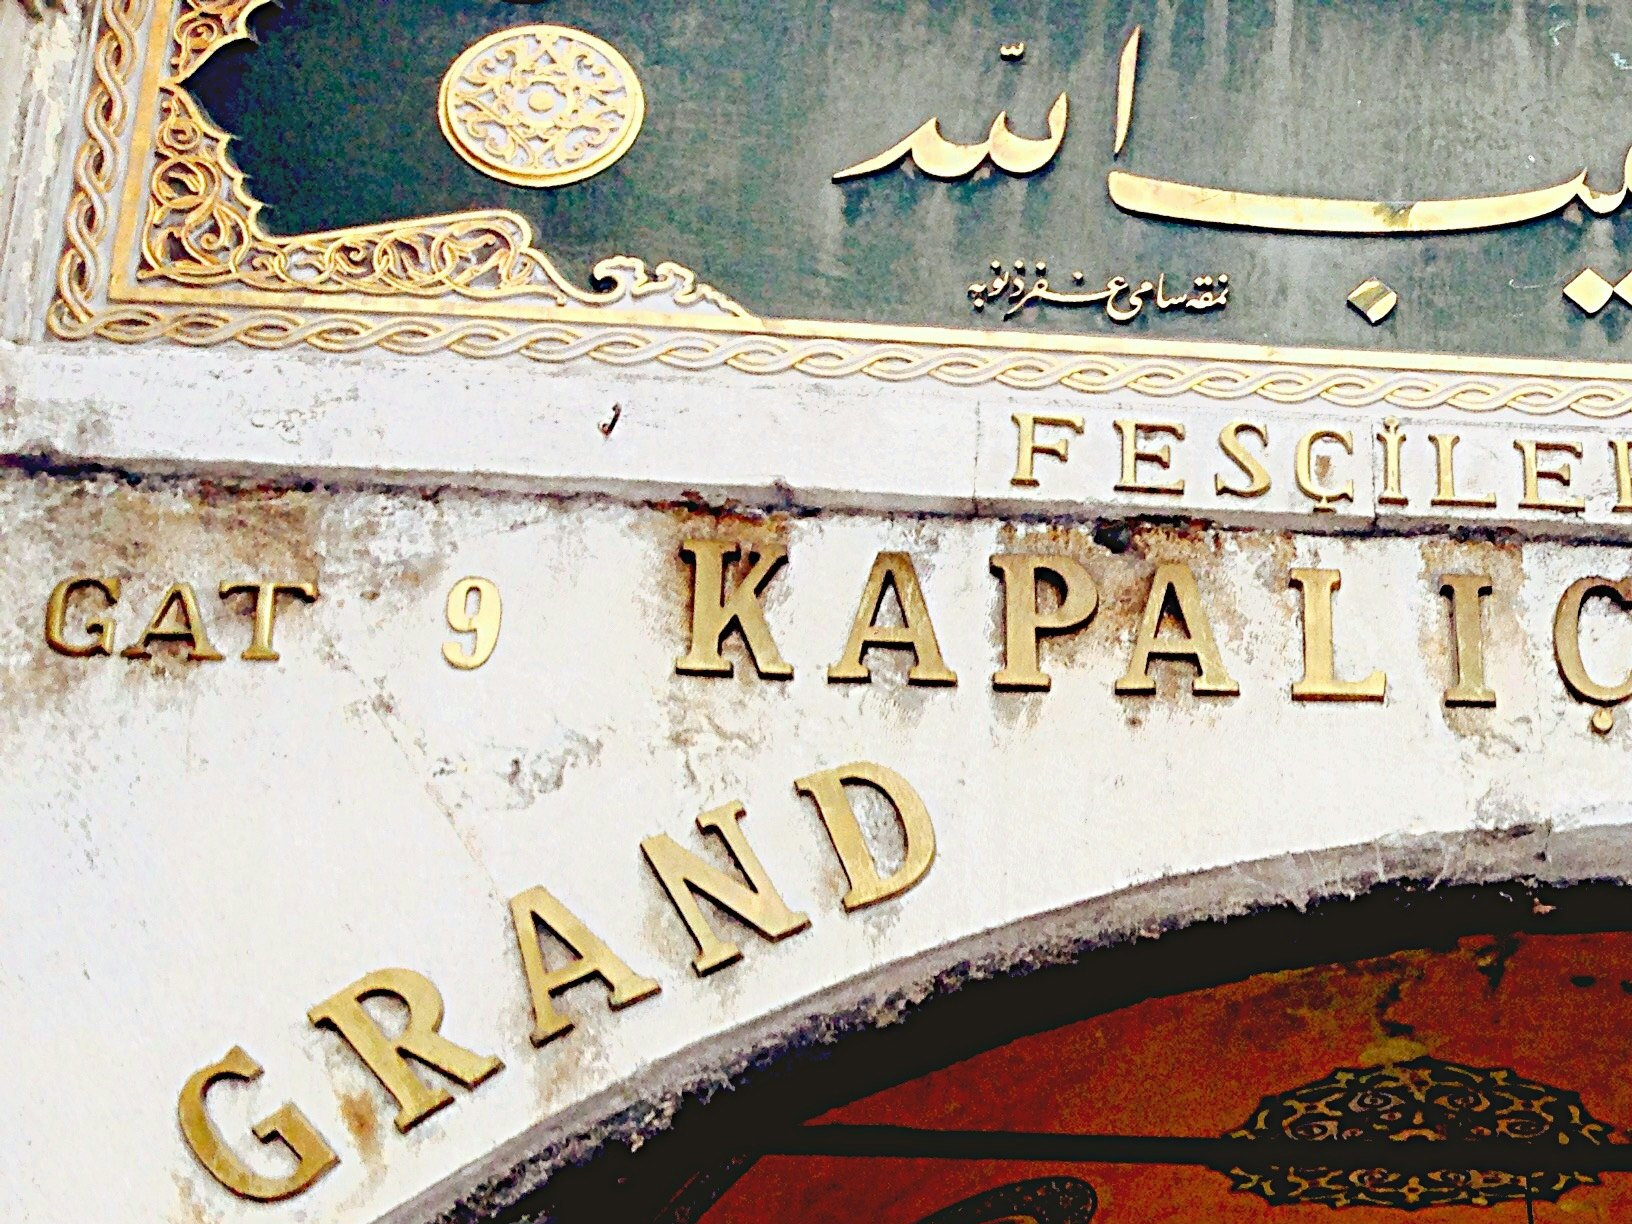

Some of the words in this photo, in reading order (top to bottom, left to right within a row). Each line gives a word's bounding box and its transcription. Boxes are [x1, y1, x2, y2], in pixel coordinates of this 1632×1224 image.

[832, 24, 1142, 186] الله
[44, 576, 321, 663] GAT
[440, 575, 504, 671] 9
[177, 761, 937, 1202] GRAND
